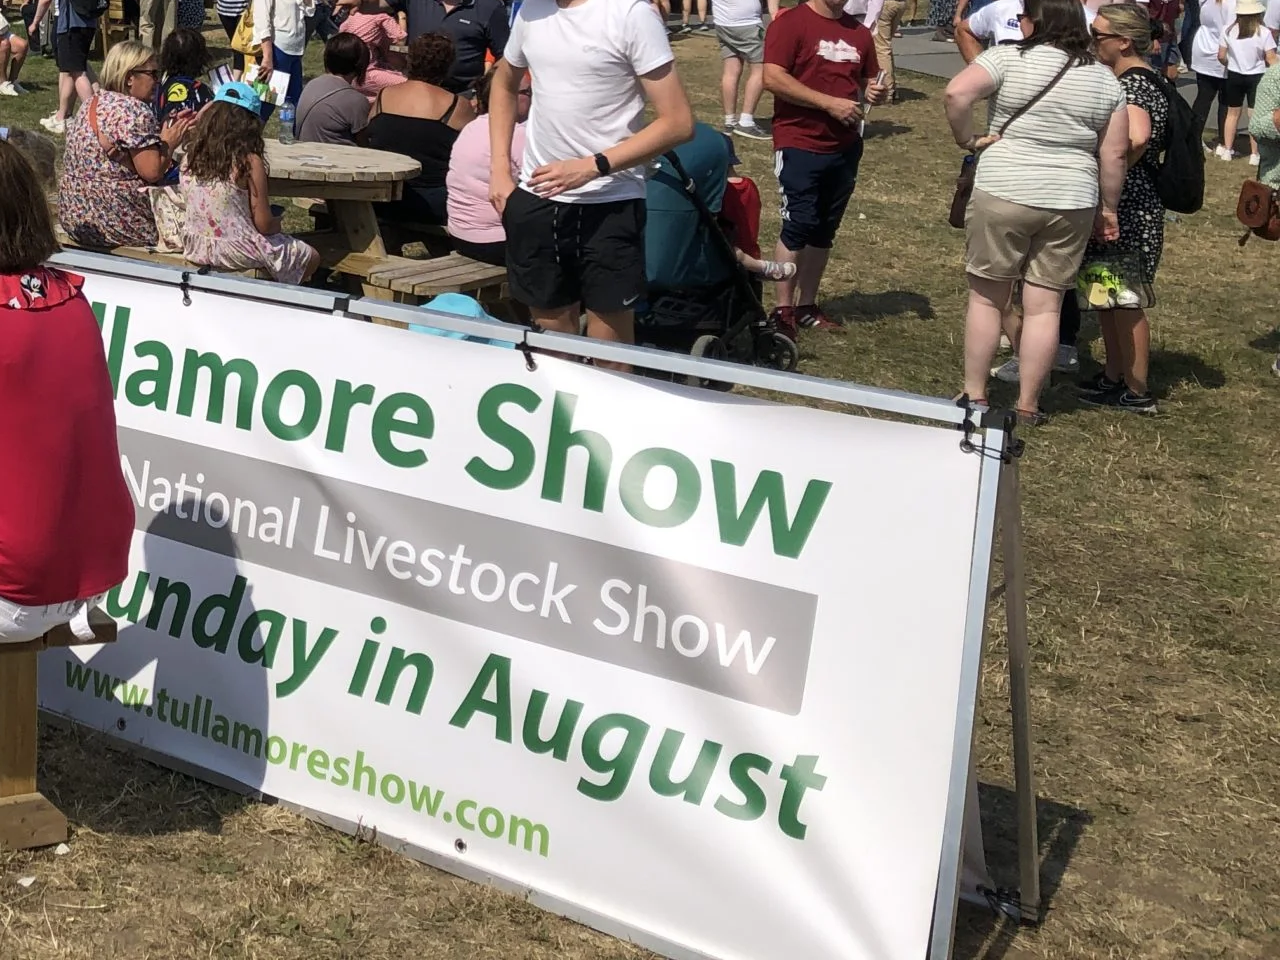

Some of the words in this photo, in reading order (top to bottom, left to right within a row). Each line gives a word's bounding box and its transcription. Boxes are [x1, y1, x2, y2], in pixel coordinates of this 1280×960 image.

[93, 303, 434, 468] lamore
[465, 383, 833, 558] Show
[121, 455, 301, 549] National
[314, 505, 579, 625] Livestock
[592, 579, 777, 675] Show
[65, 660, 549, 856] www.tullamoreshow.com
[105, 571, 340, 698] unday
[348, 617, 433, 713] in
[451, 653, 826, 838] August
